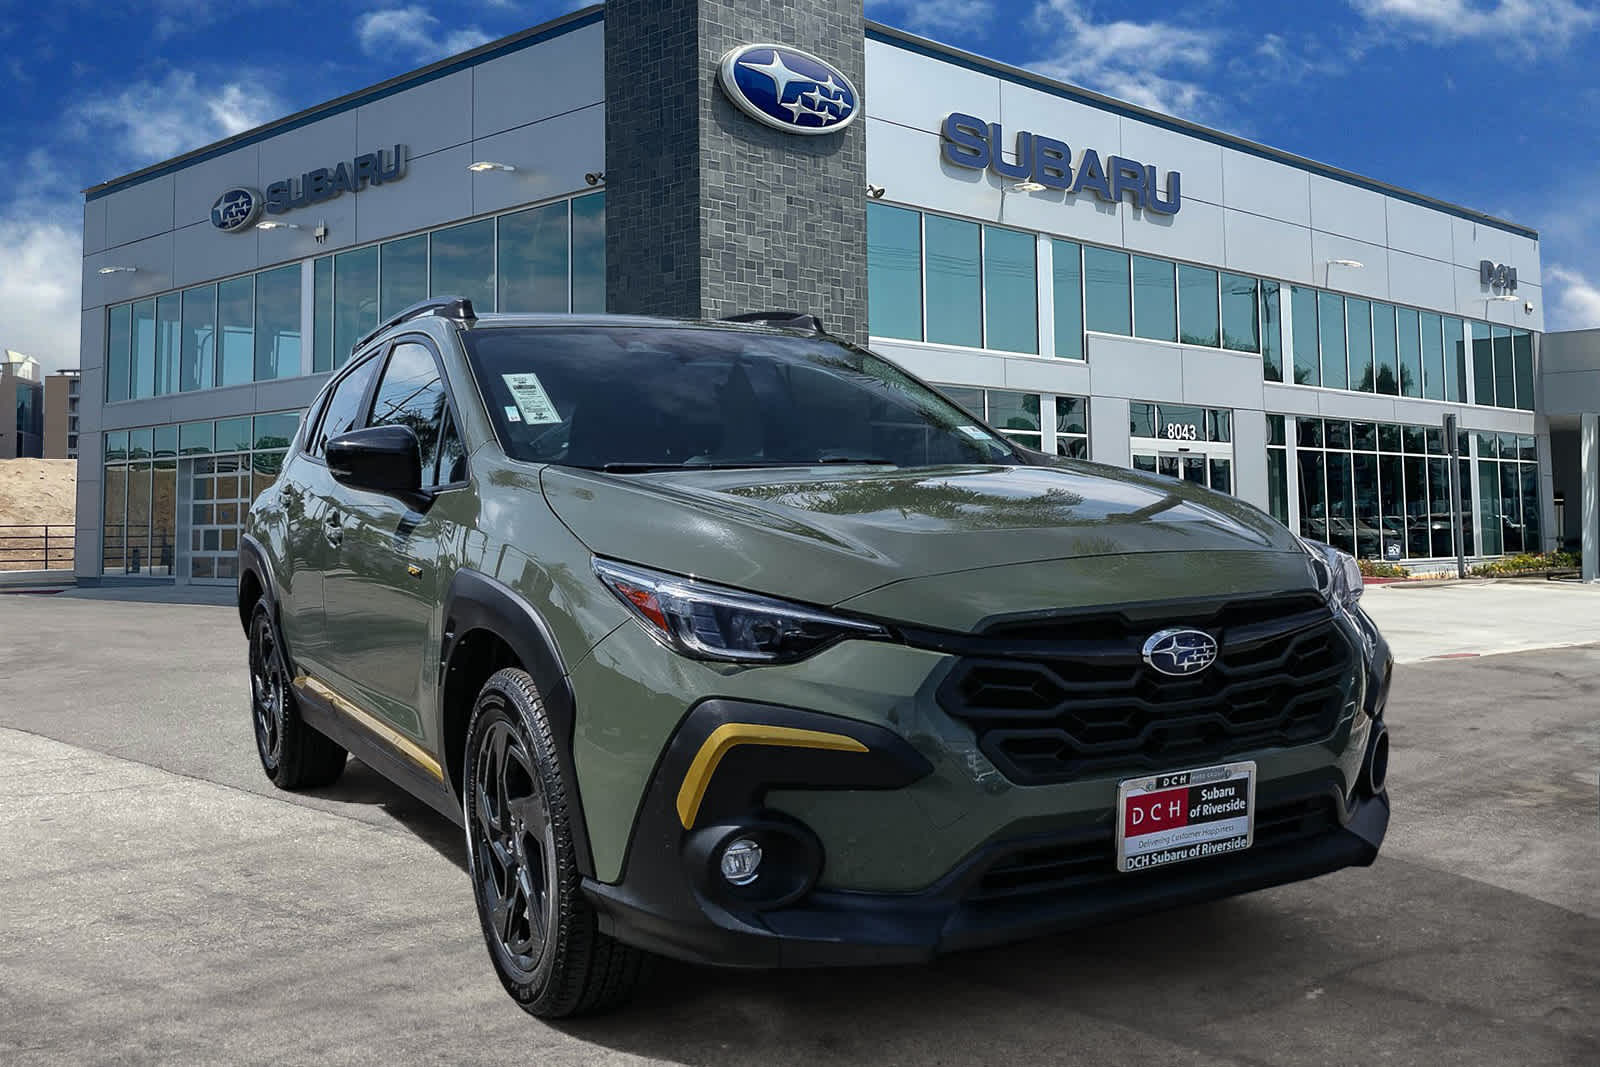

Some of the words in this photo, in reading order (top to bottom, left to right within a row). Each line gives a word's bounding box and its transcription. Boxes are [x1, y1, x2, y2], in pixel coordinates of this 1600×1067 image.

[942, 112, 1181, 215] SUBARU
[266, 144, 408, 214] SUBARU
[1167, 423, 1197, 440] 8043
[1163, 775, 1187, 786] DCH
[1201, 786, 1235, 801] Subaru
[1189, 804, 1202, 818] of
[1202, 798, 1246, 817] Riverside
[1138, 835, 1171, 849] Delivering
[1171, 830, 1201, 843] Customer
[1127, 854, 1150, 870] DCH
[1151, 849, 1188, 865] Subaru
[1189, 844, 1201, 857] of
[1202, 837, 1247, 855] Riverside
